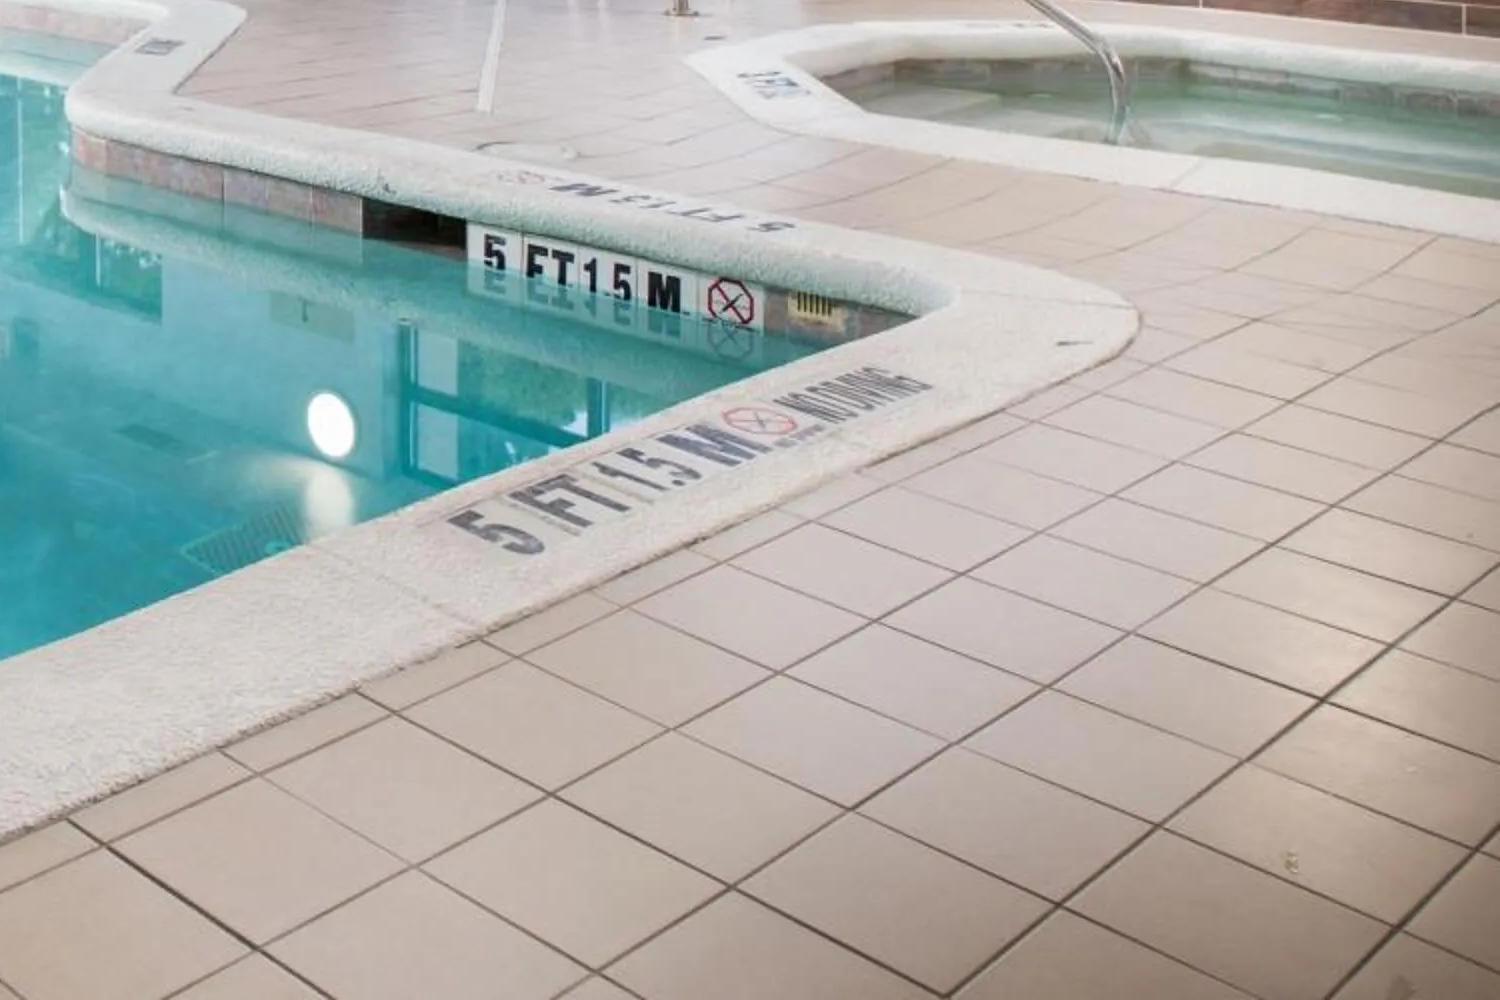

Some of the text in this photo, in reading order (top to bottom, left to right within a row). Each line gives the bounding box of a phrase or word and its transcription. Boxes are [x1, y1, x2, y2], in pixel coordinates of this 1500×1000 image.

[484, 233, 507, 271] 5
[772, 391, 859, 424] NO
[447, 509, 546, 555] 5
[508, 473, 630, 528] FT
[593, 447, 702, 491] 1.5
[660, 420, 773, 467] M
